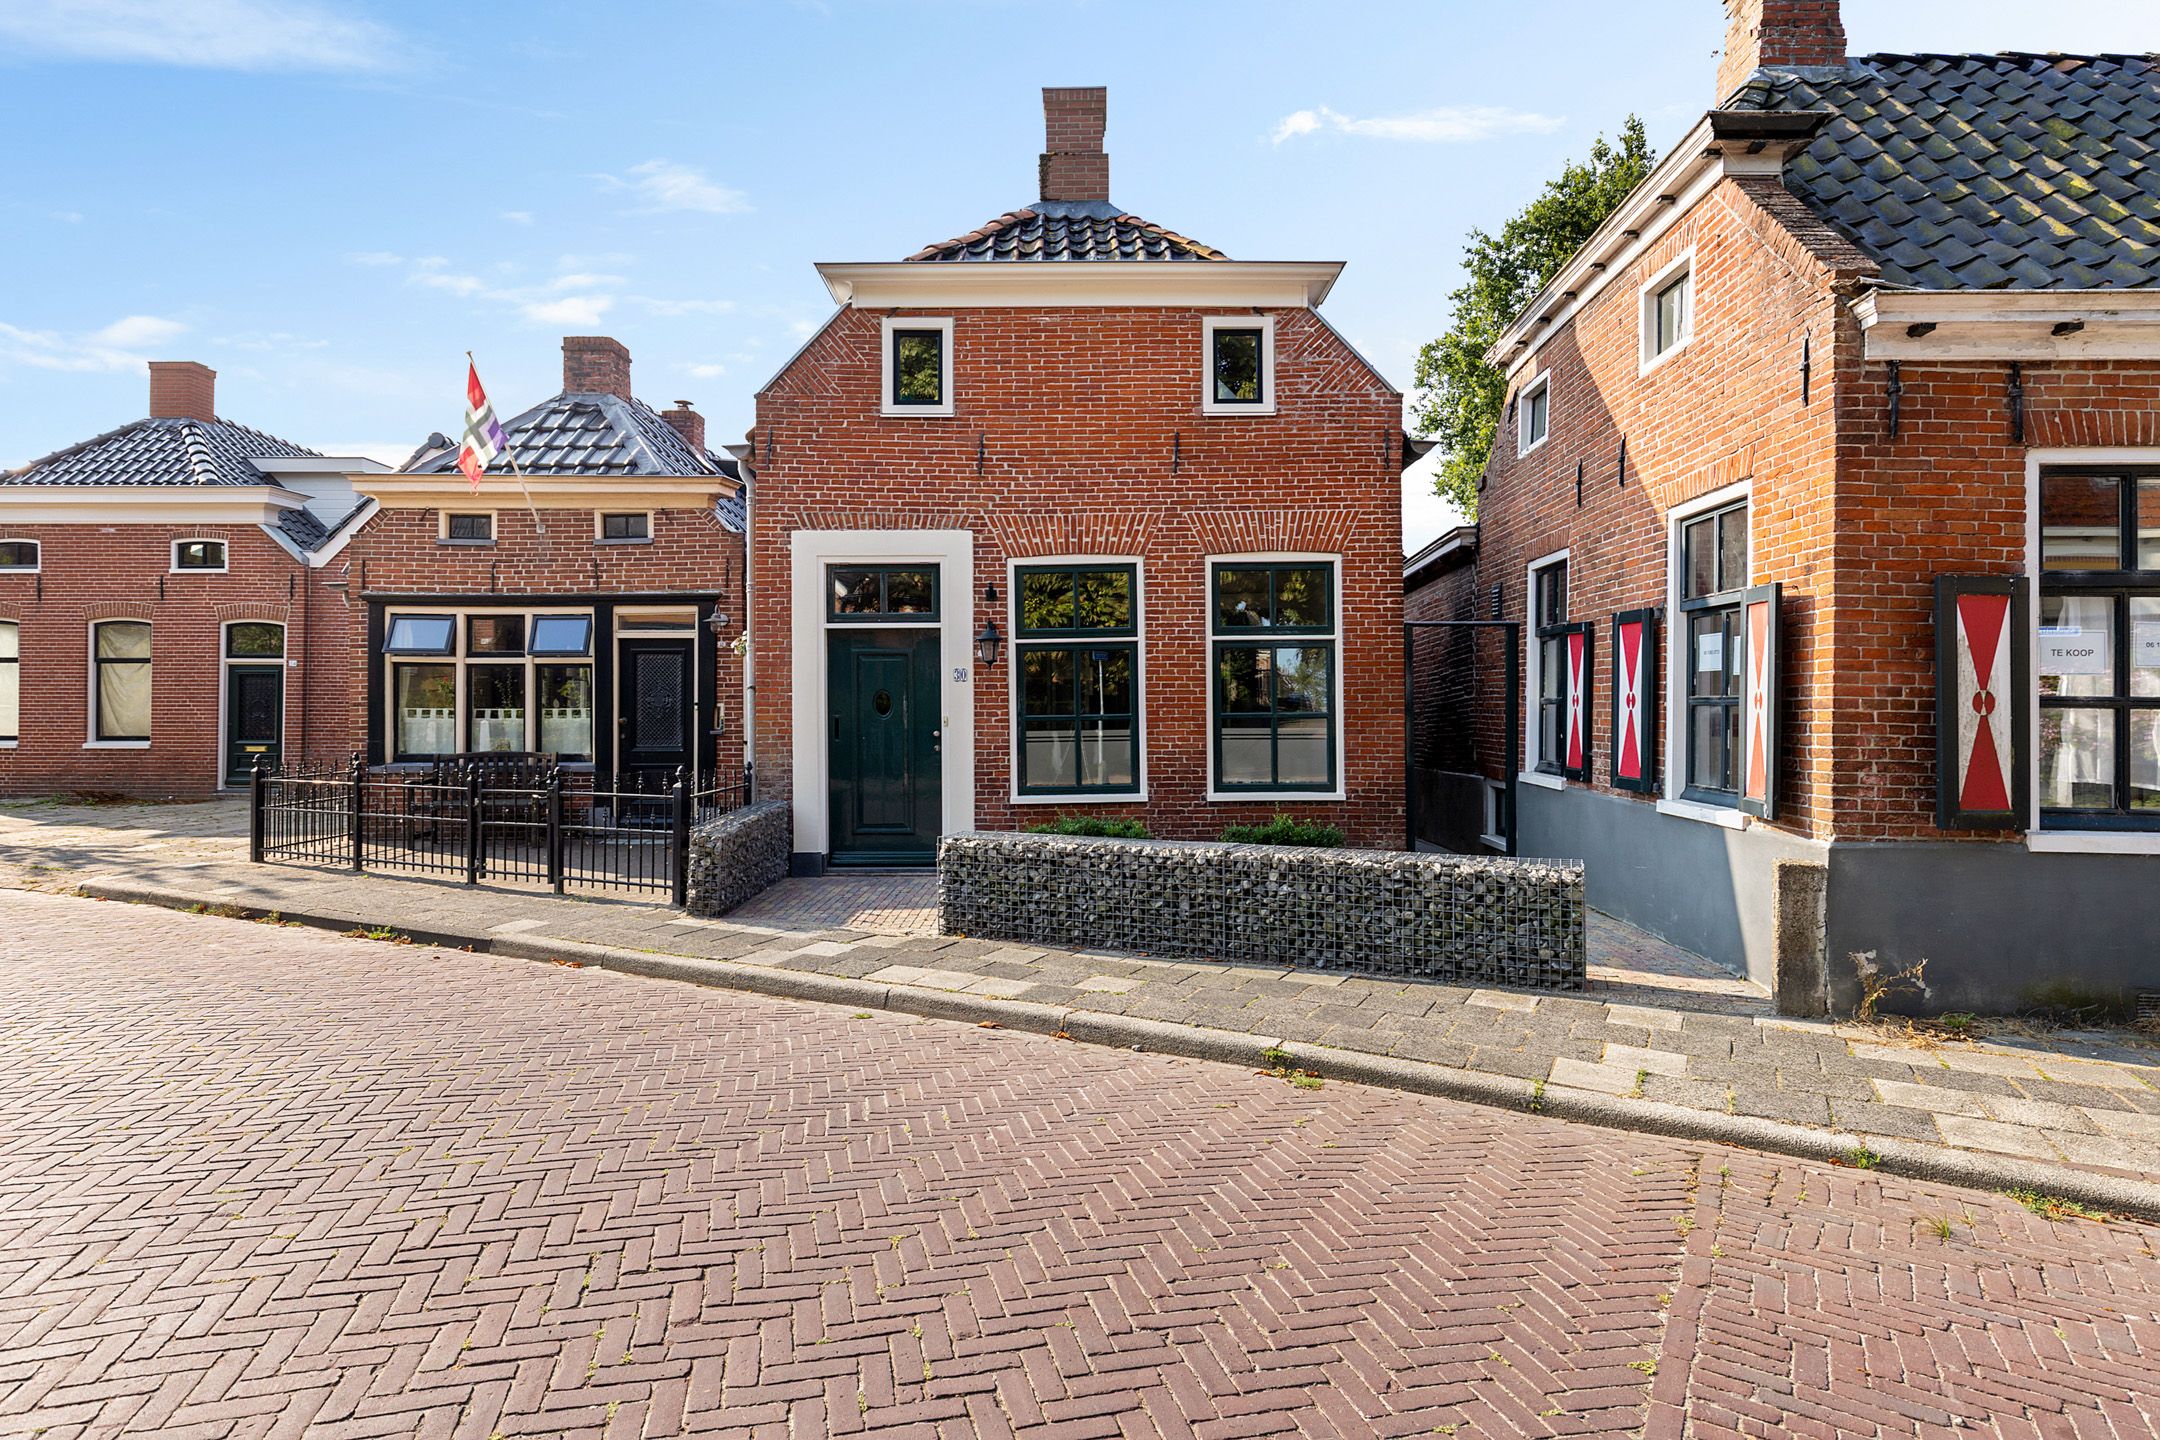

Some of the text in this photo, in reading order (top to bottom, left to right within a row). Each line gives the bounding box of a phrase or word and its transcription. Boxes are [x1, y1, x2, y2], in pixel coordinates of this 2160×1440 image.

[2051, 649, 2094, 657] TE KOOP
[953, 668, 967, 682] 30
